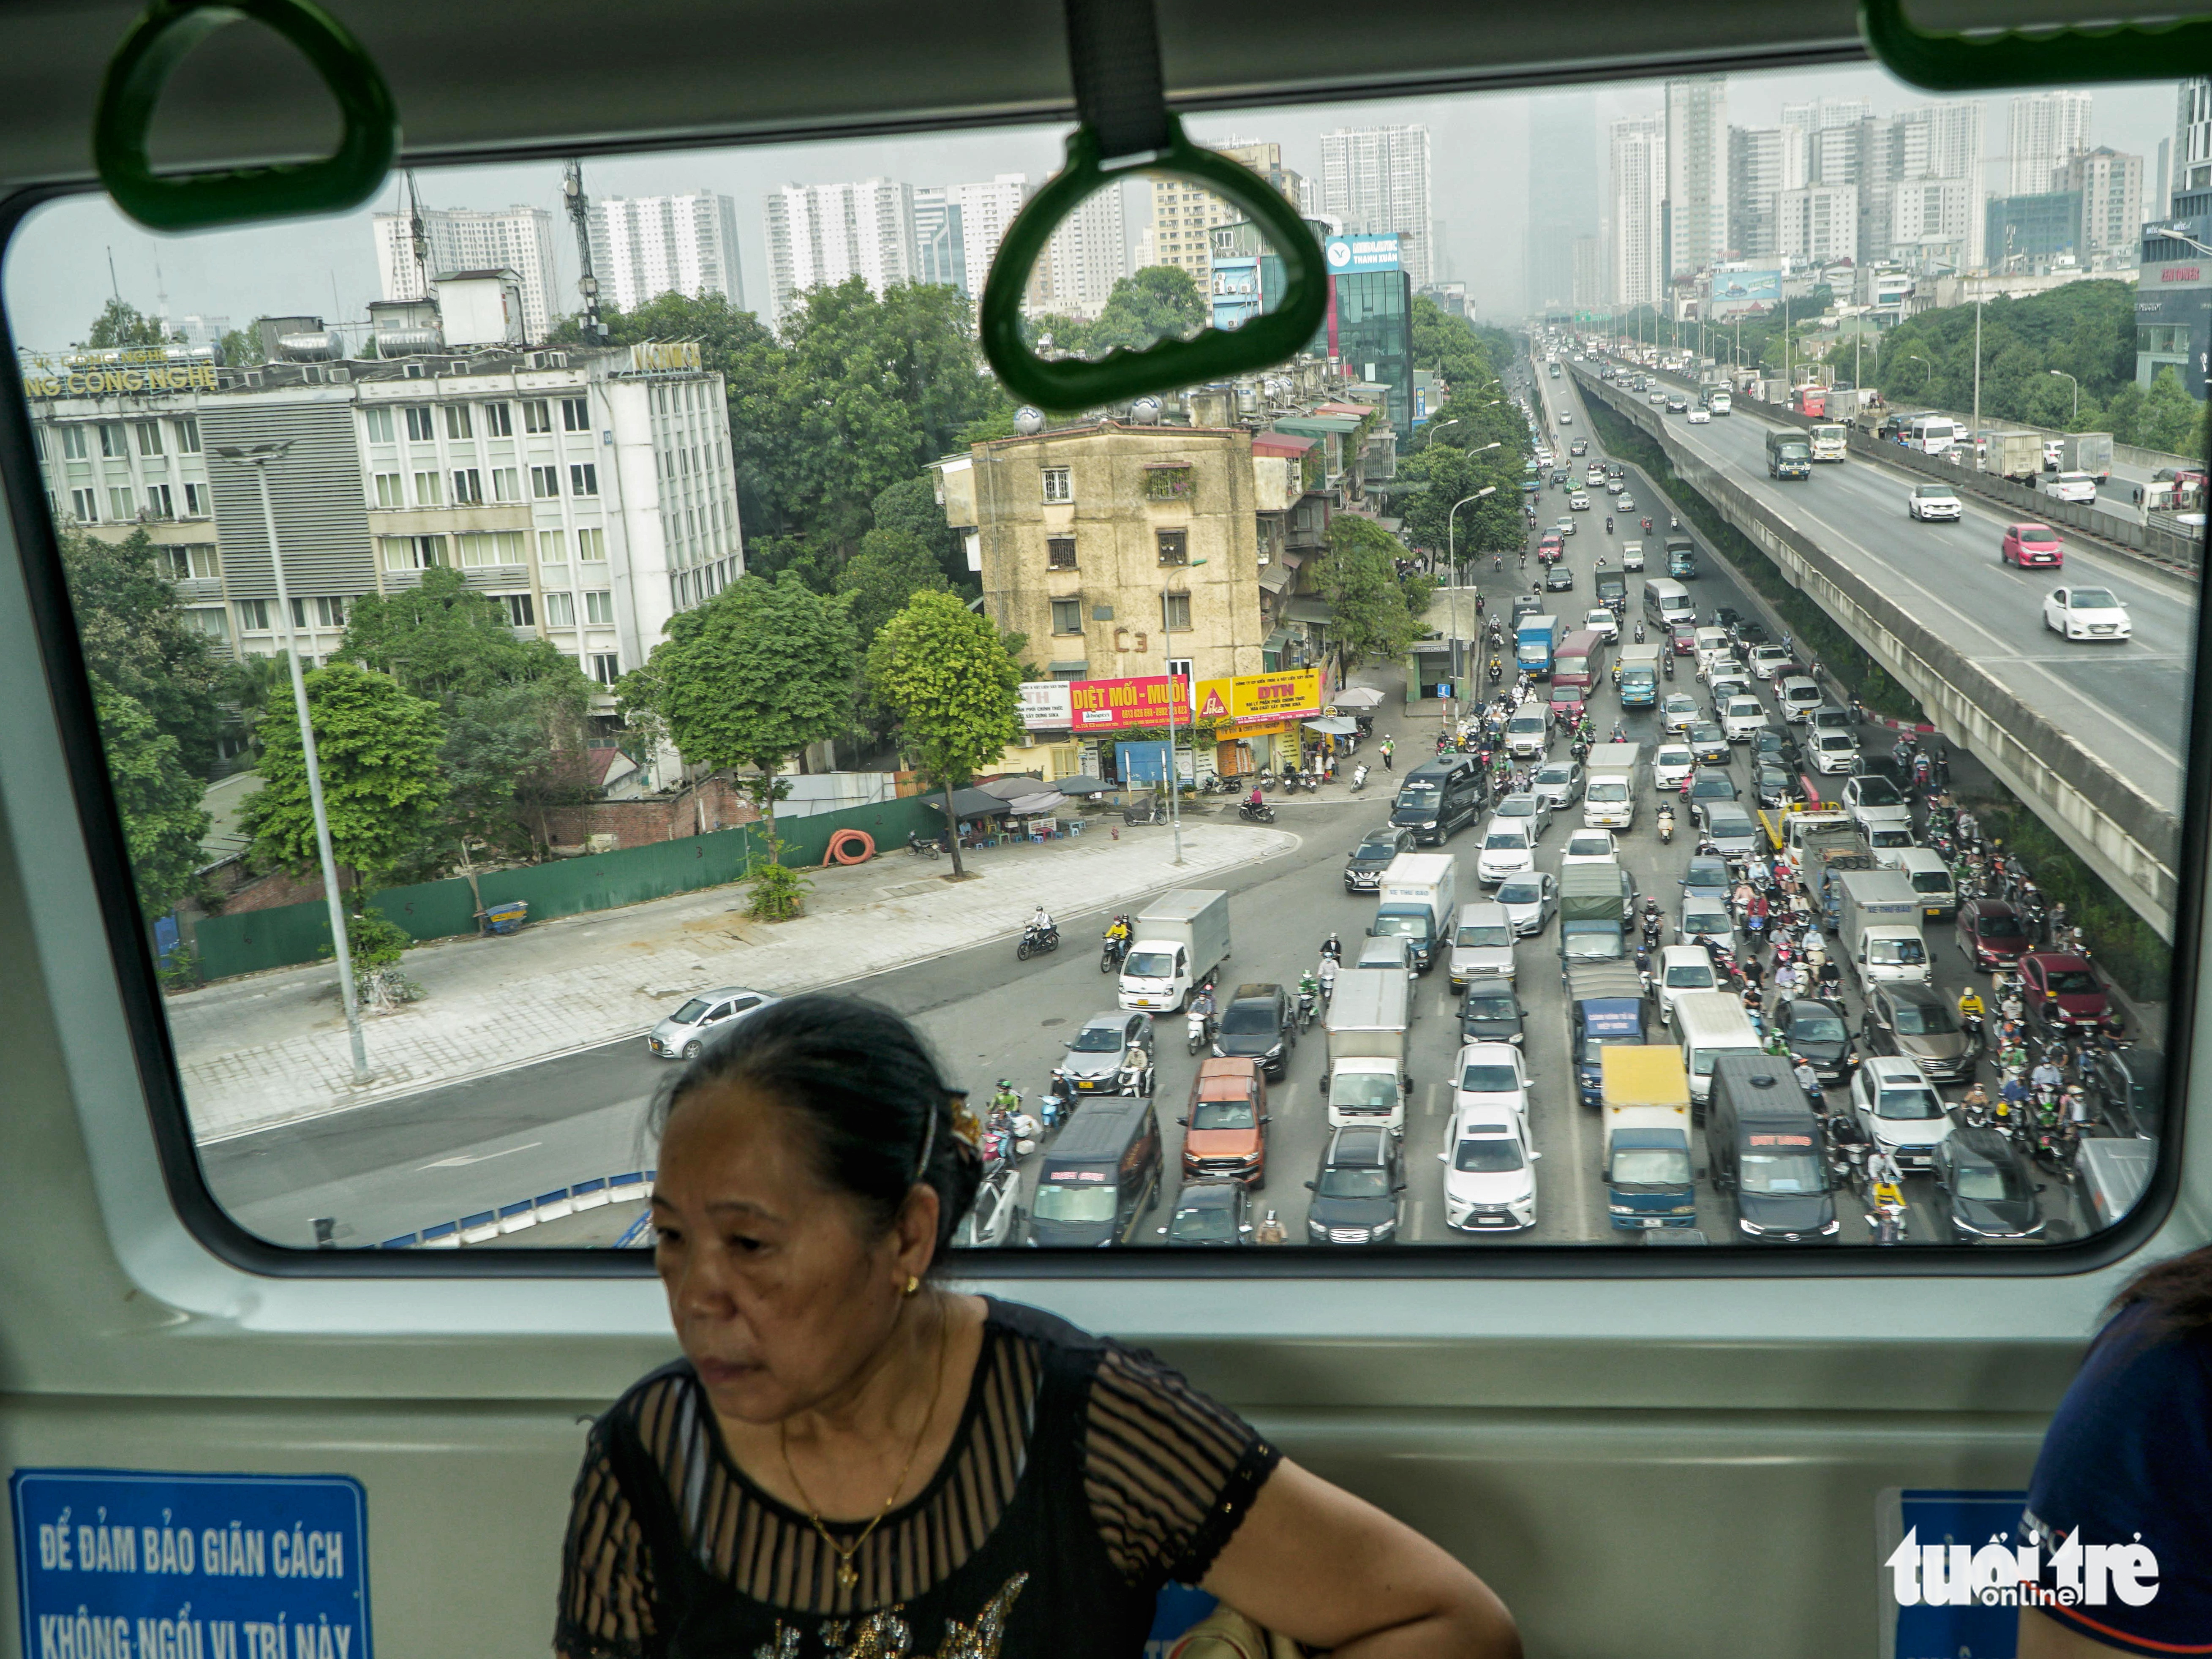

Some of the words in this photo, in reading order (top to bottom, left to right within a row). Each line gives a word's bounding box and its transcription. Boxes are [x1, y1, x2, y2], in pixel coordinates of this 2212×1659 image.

[1354, 255, 1377, 264] THANH
[1378, 252, 1397, 262] XUÂN
[68, 367, 143, 394] CÔNG
[148, 359, 216, 390] NGHỆ
[1114, 628, 1147, 653] C3
[1072, 685, 1105, 712] DIỆT
[1109, 681, 1138, 707] MỐI
[1147, 676, 1186, 705] MUỖI
[1258, 684, 1294, 699] DTH
[1203, 697, 1224, 715] Sika
[1777, 1136, 1812, 1146] LONG
[39, 1505, 73, 1572] ĐỂ
[77, 1505, 136, 1573] ĐẢM
[142, 1507, 195, 1575] BẢO
[202, 1520, 265, 1577] GIÃN
[272, 1520, 344, 1579] CÁCH
[38, 1604, 131, 1659] KHÔNG
[242, 1610, 288, 1659] TRÍ
[294, 1612, 351, 1659] NÀY
